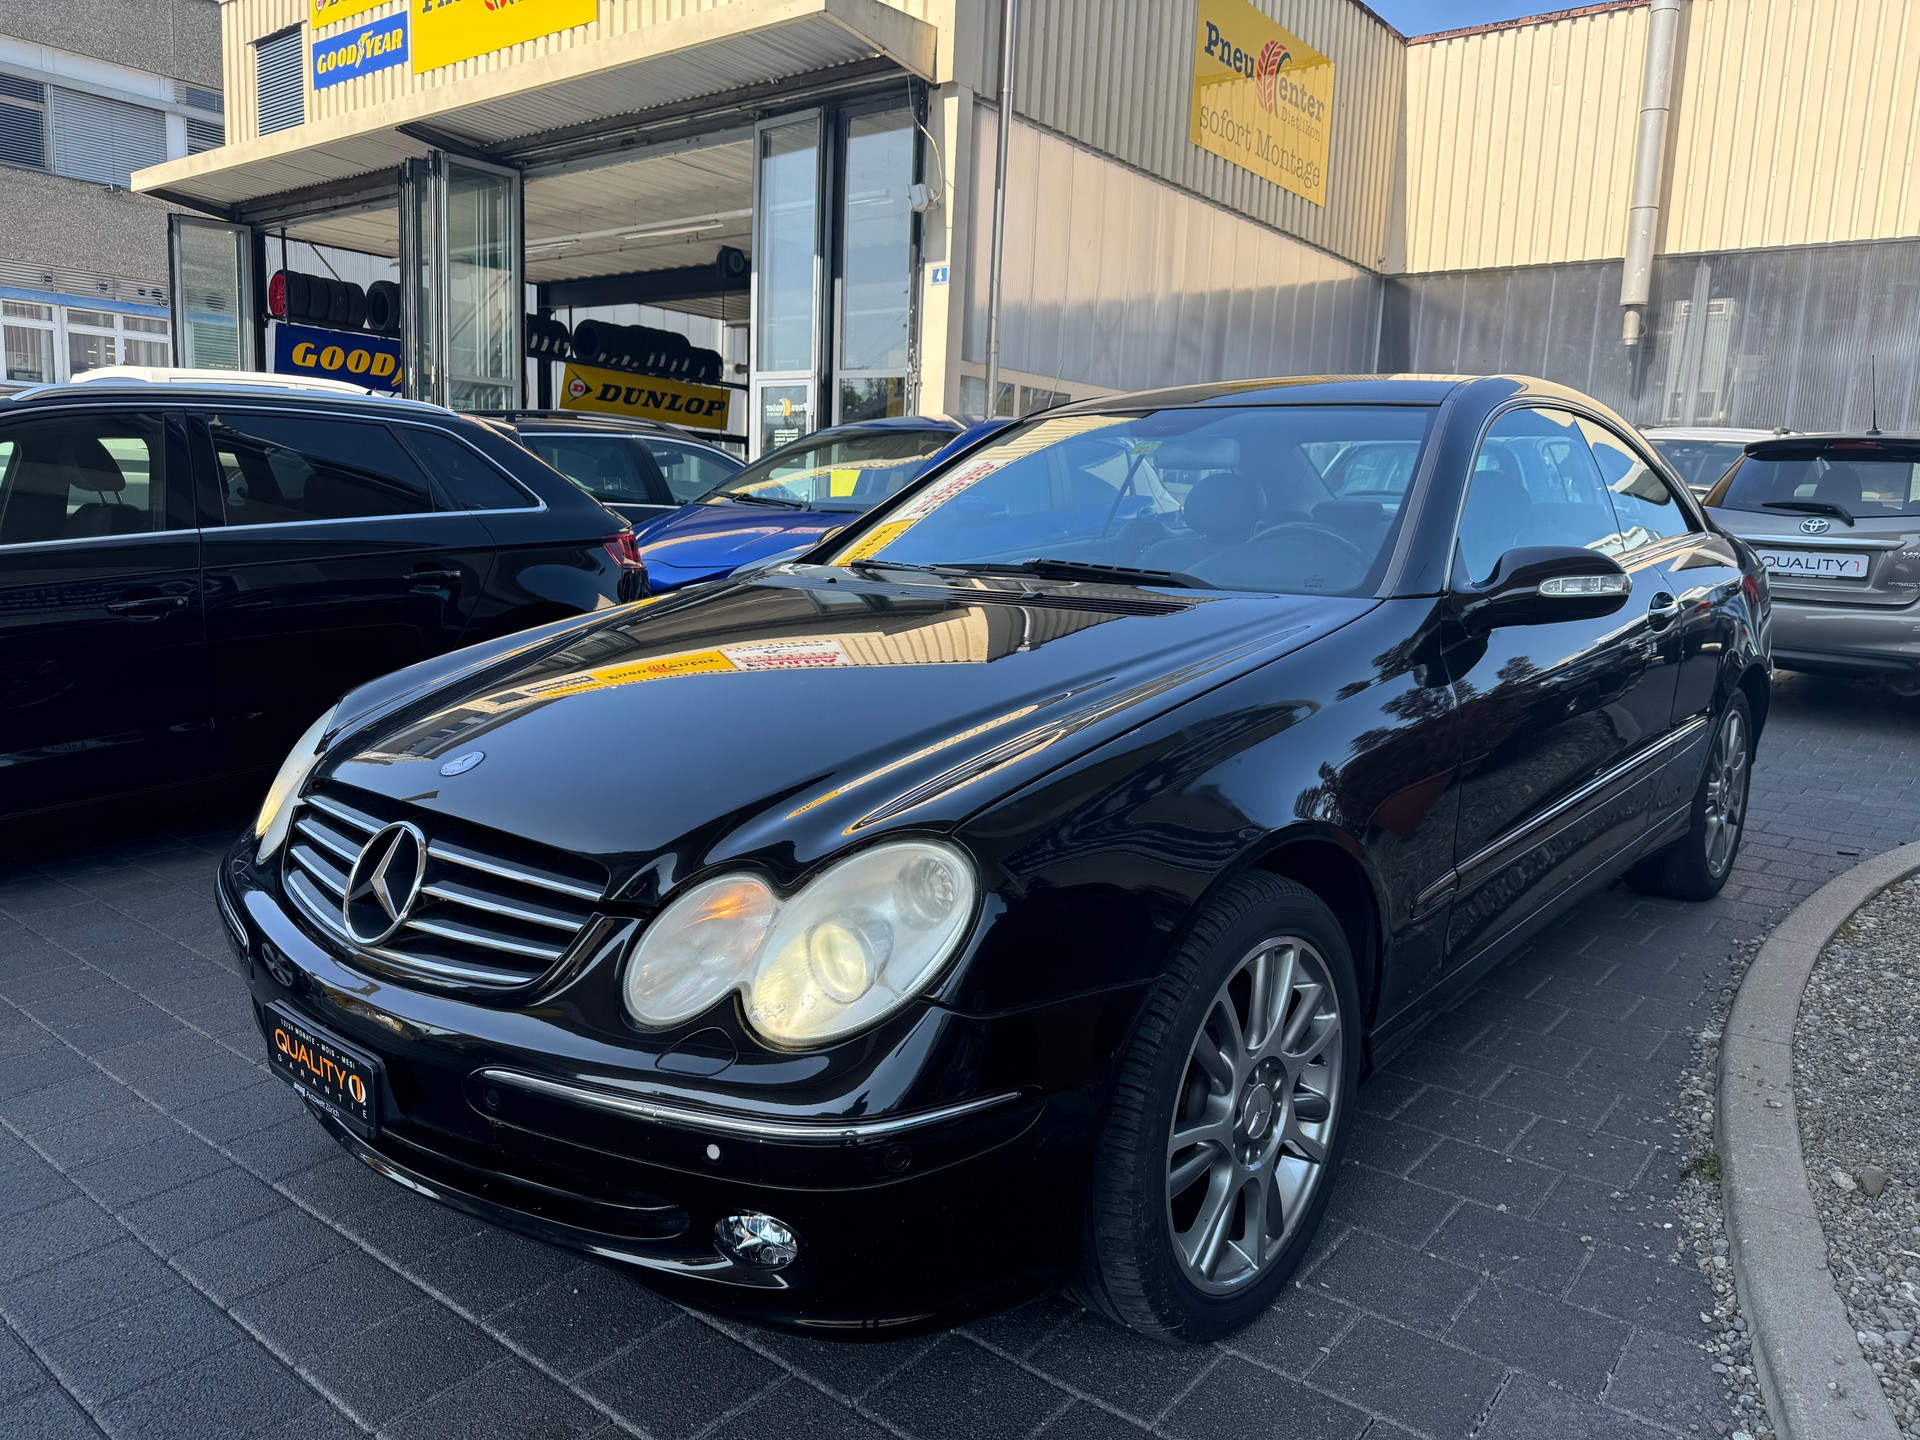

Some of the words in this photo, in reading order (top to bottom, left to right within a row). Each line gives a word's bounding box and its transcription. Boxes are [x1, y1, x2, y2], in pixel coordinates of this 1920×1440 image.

[316, 28, 403, 74] GOODYEAR
[1204, 20, 1255, 80] Pneu
[1281, 106, 1321, 142] Dietlikon
[1254, 128, 1321, 189] Montage
[292, 342, 397, 378] GOOD
[595, 383, 725, 416] DUNLOP
[1761, 555, 1849, 572] QUALITY
[1853, 560, 1860, 573] 1
[275, 1028, 346, 1089] QUALITY
[295, 1028, 316, 1045] MONATE
[321, 1043, 335, 1058] MOIS
[341, 1055, 356, 1070] MESI
